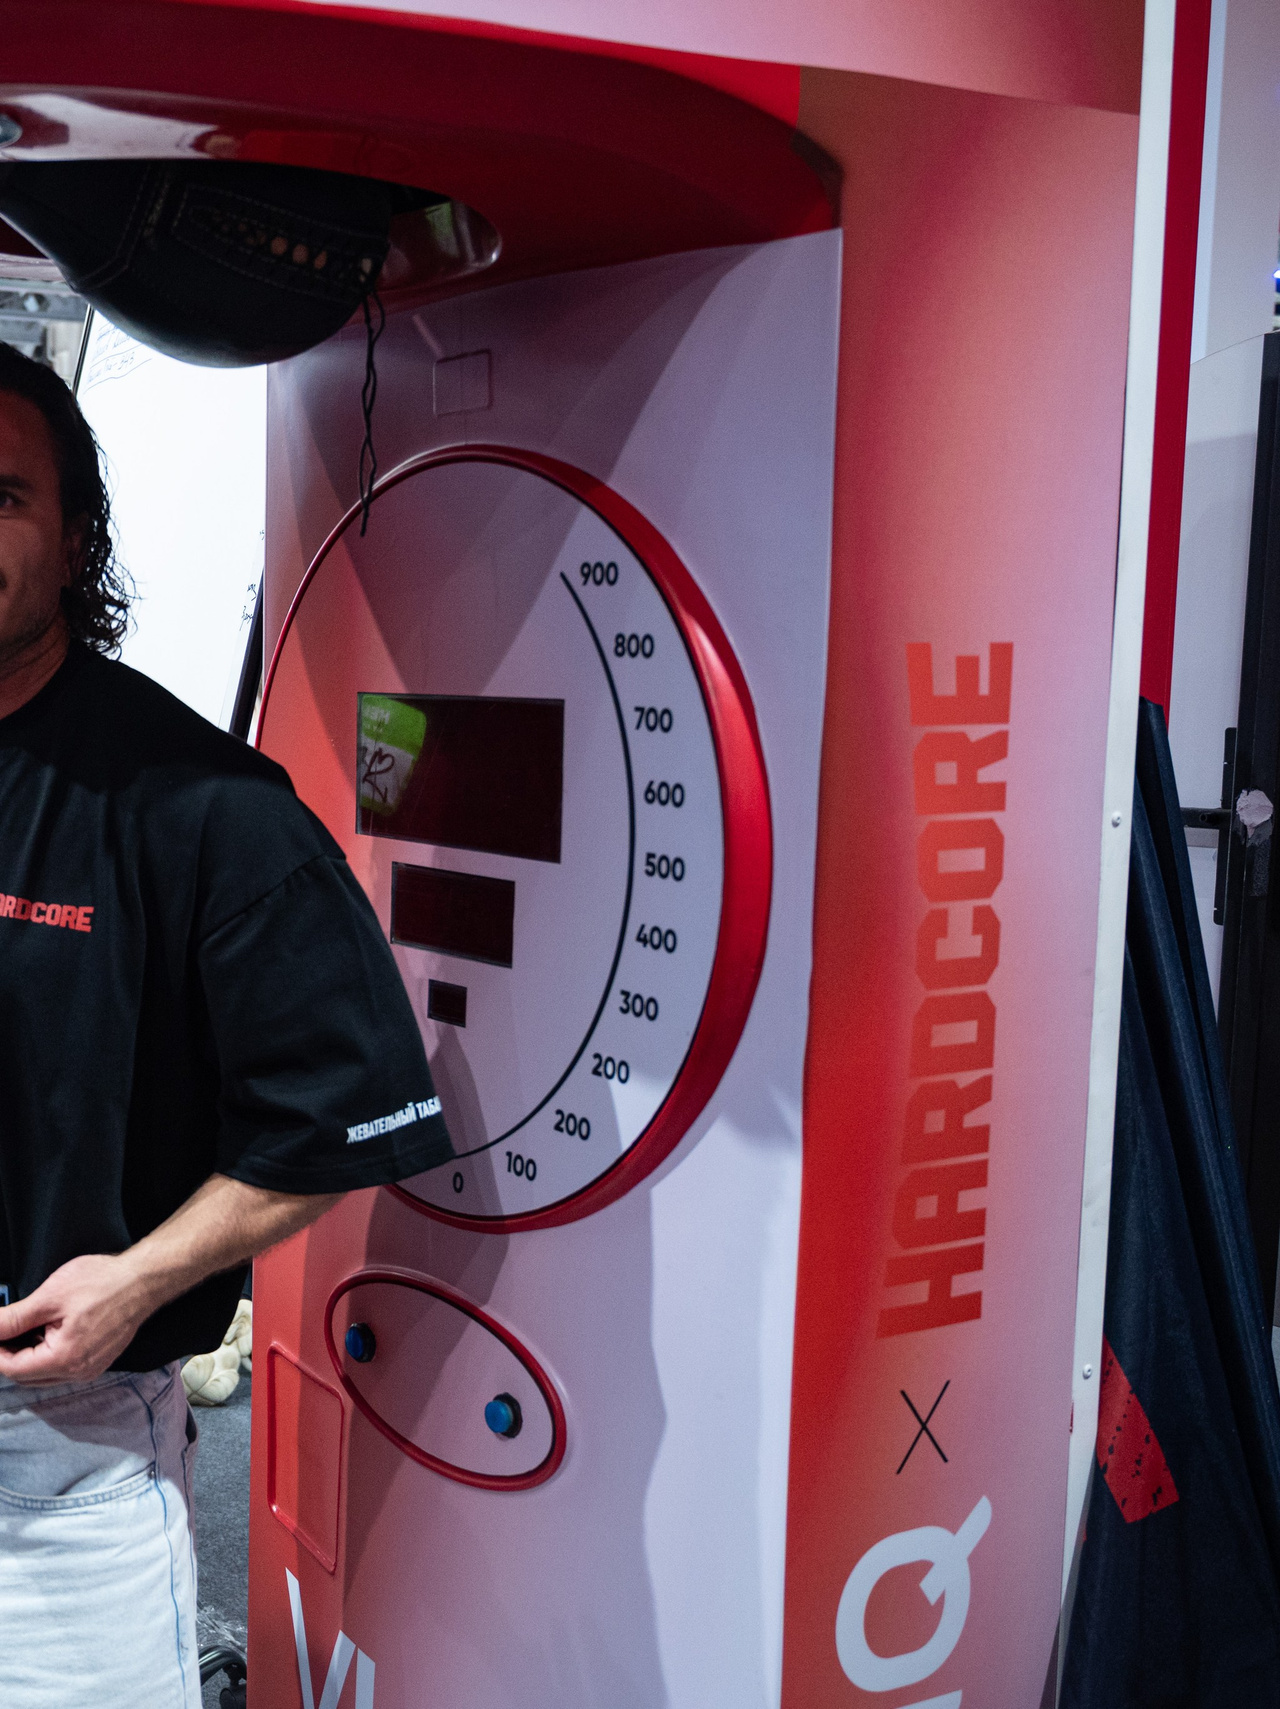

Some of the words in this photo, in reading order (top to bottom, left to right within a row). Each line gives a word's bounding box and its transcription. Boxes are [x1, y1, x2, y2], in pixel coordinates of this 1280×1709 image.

[580, 562, 619, 587] 900
[614, 633, 655, 659] 800
[634, 706, 673, 733] 700
[644, 781, 685, 809] 600
[645, 852, 686, 882] 500
[635, 924, 677, 954] 400
[619, 989, 659, 1022] 300
[875, 642, 1014, 1341] HARDCORE
[591, 1053, 630, 1085] 200
[346, 1101, 418, 1144] ЖЕВАТЕЛЬНЫЙ
[554, 1108, 592, 1141] 200
[505, 1151, 538, 1182] 100
[452, 1172, 464, 1193] 0
